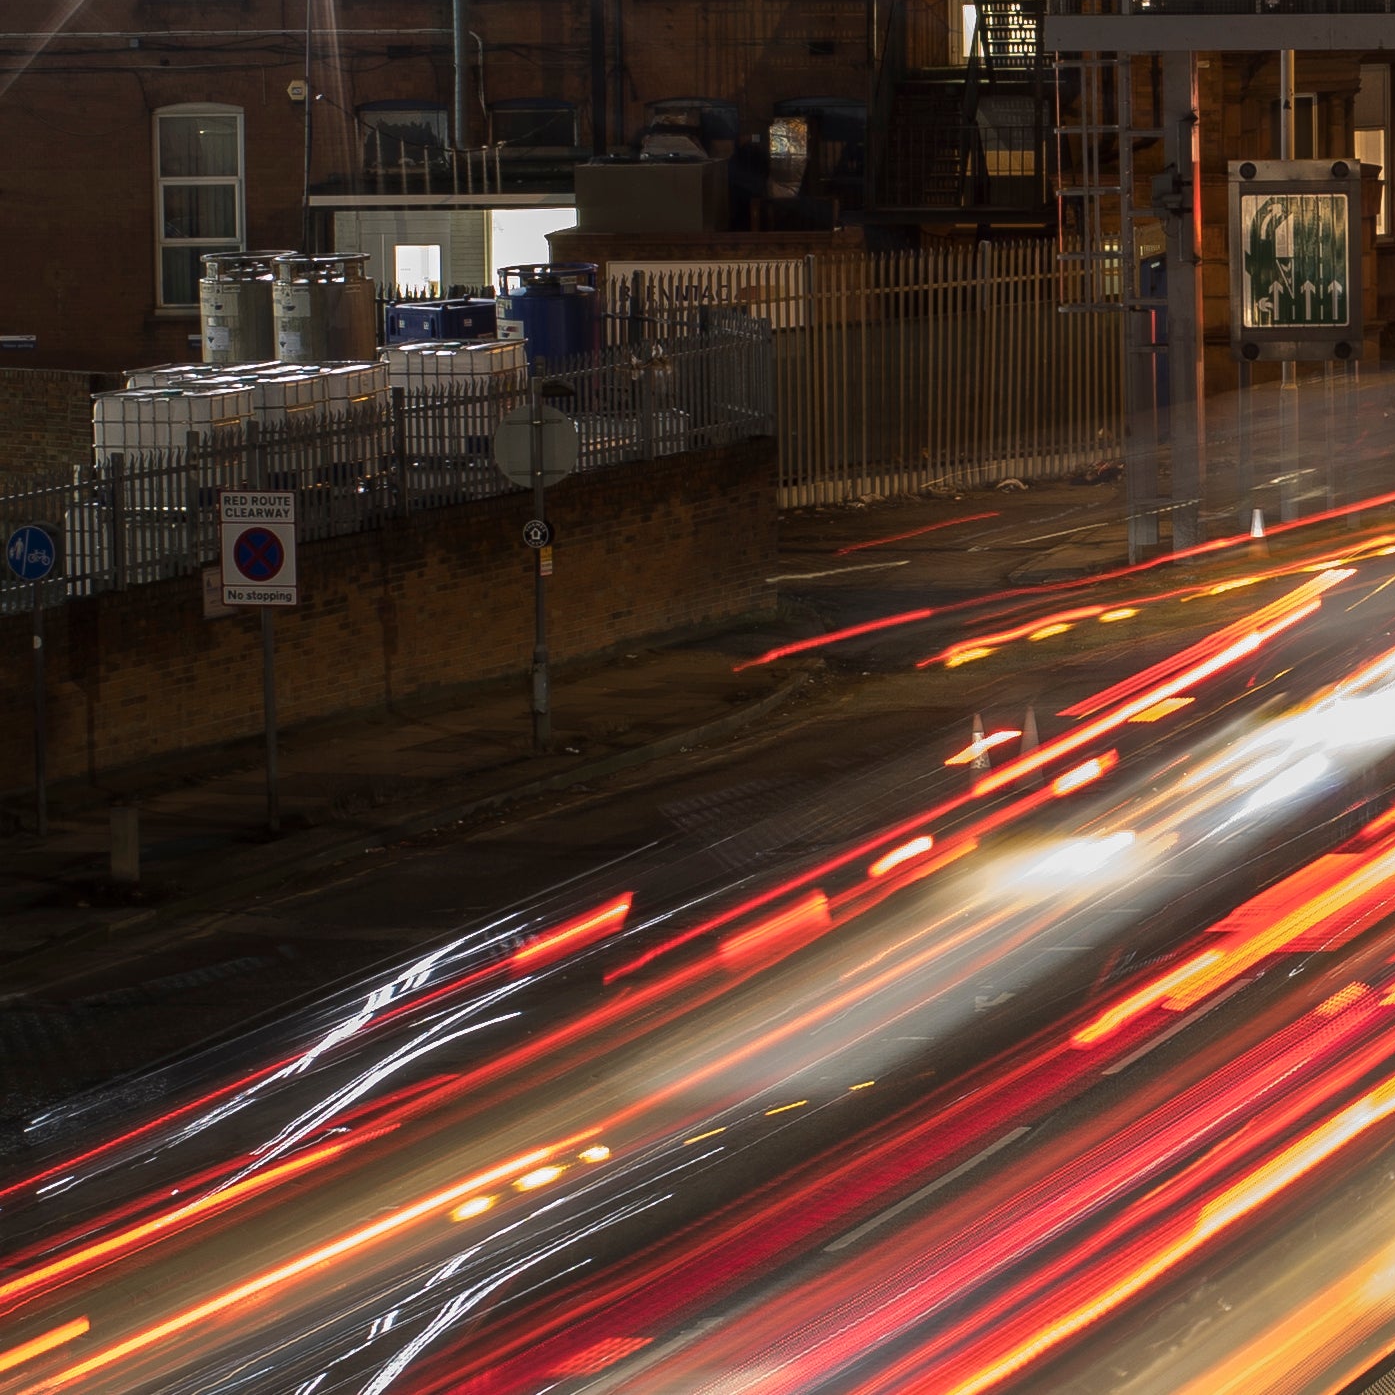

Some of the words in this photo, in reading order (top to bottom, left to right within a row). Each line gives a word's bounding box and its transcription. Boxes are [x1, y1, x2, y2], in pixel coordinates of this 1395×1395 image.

[223, 496, 248, 506] RED
[251, 496, 291, 506] ROUTE
[225, 508, 290, 518] CLEARWAY
[228, 590, 244, 600] No
[246, 591, 292, 602] stopping
